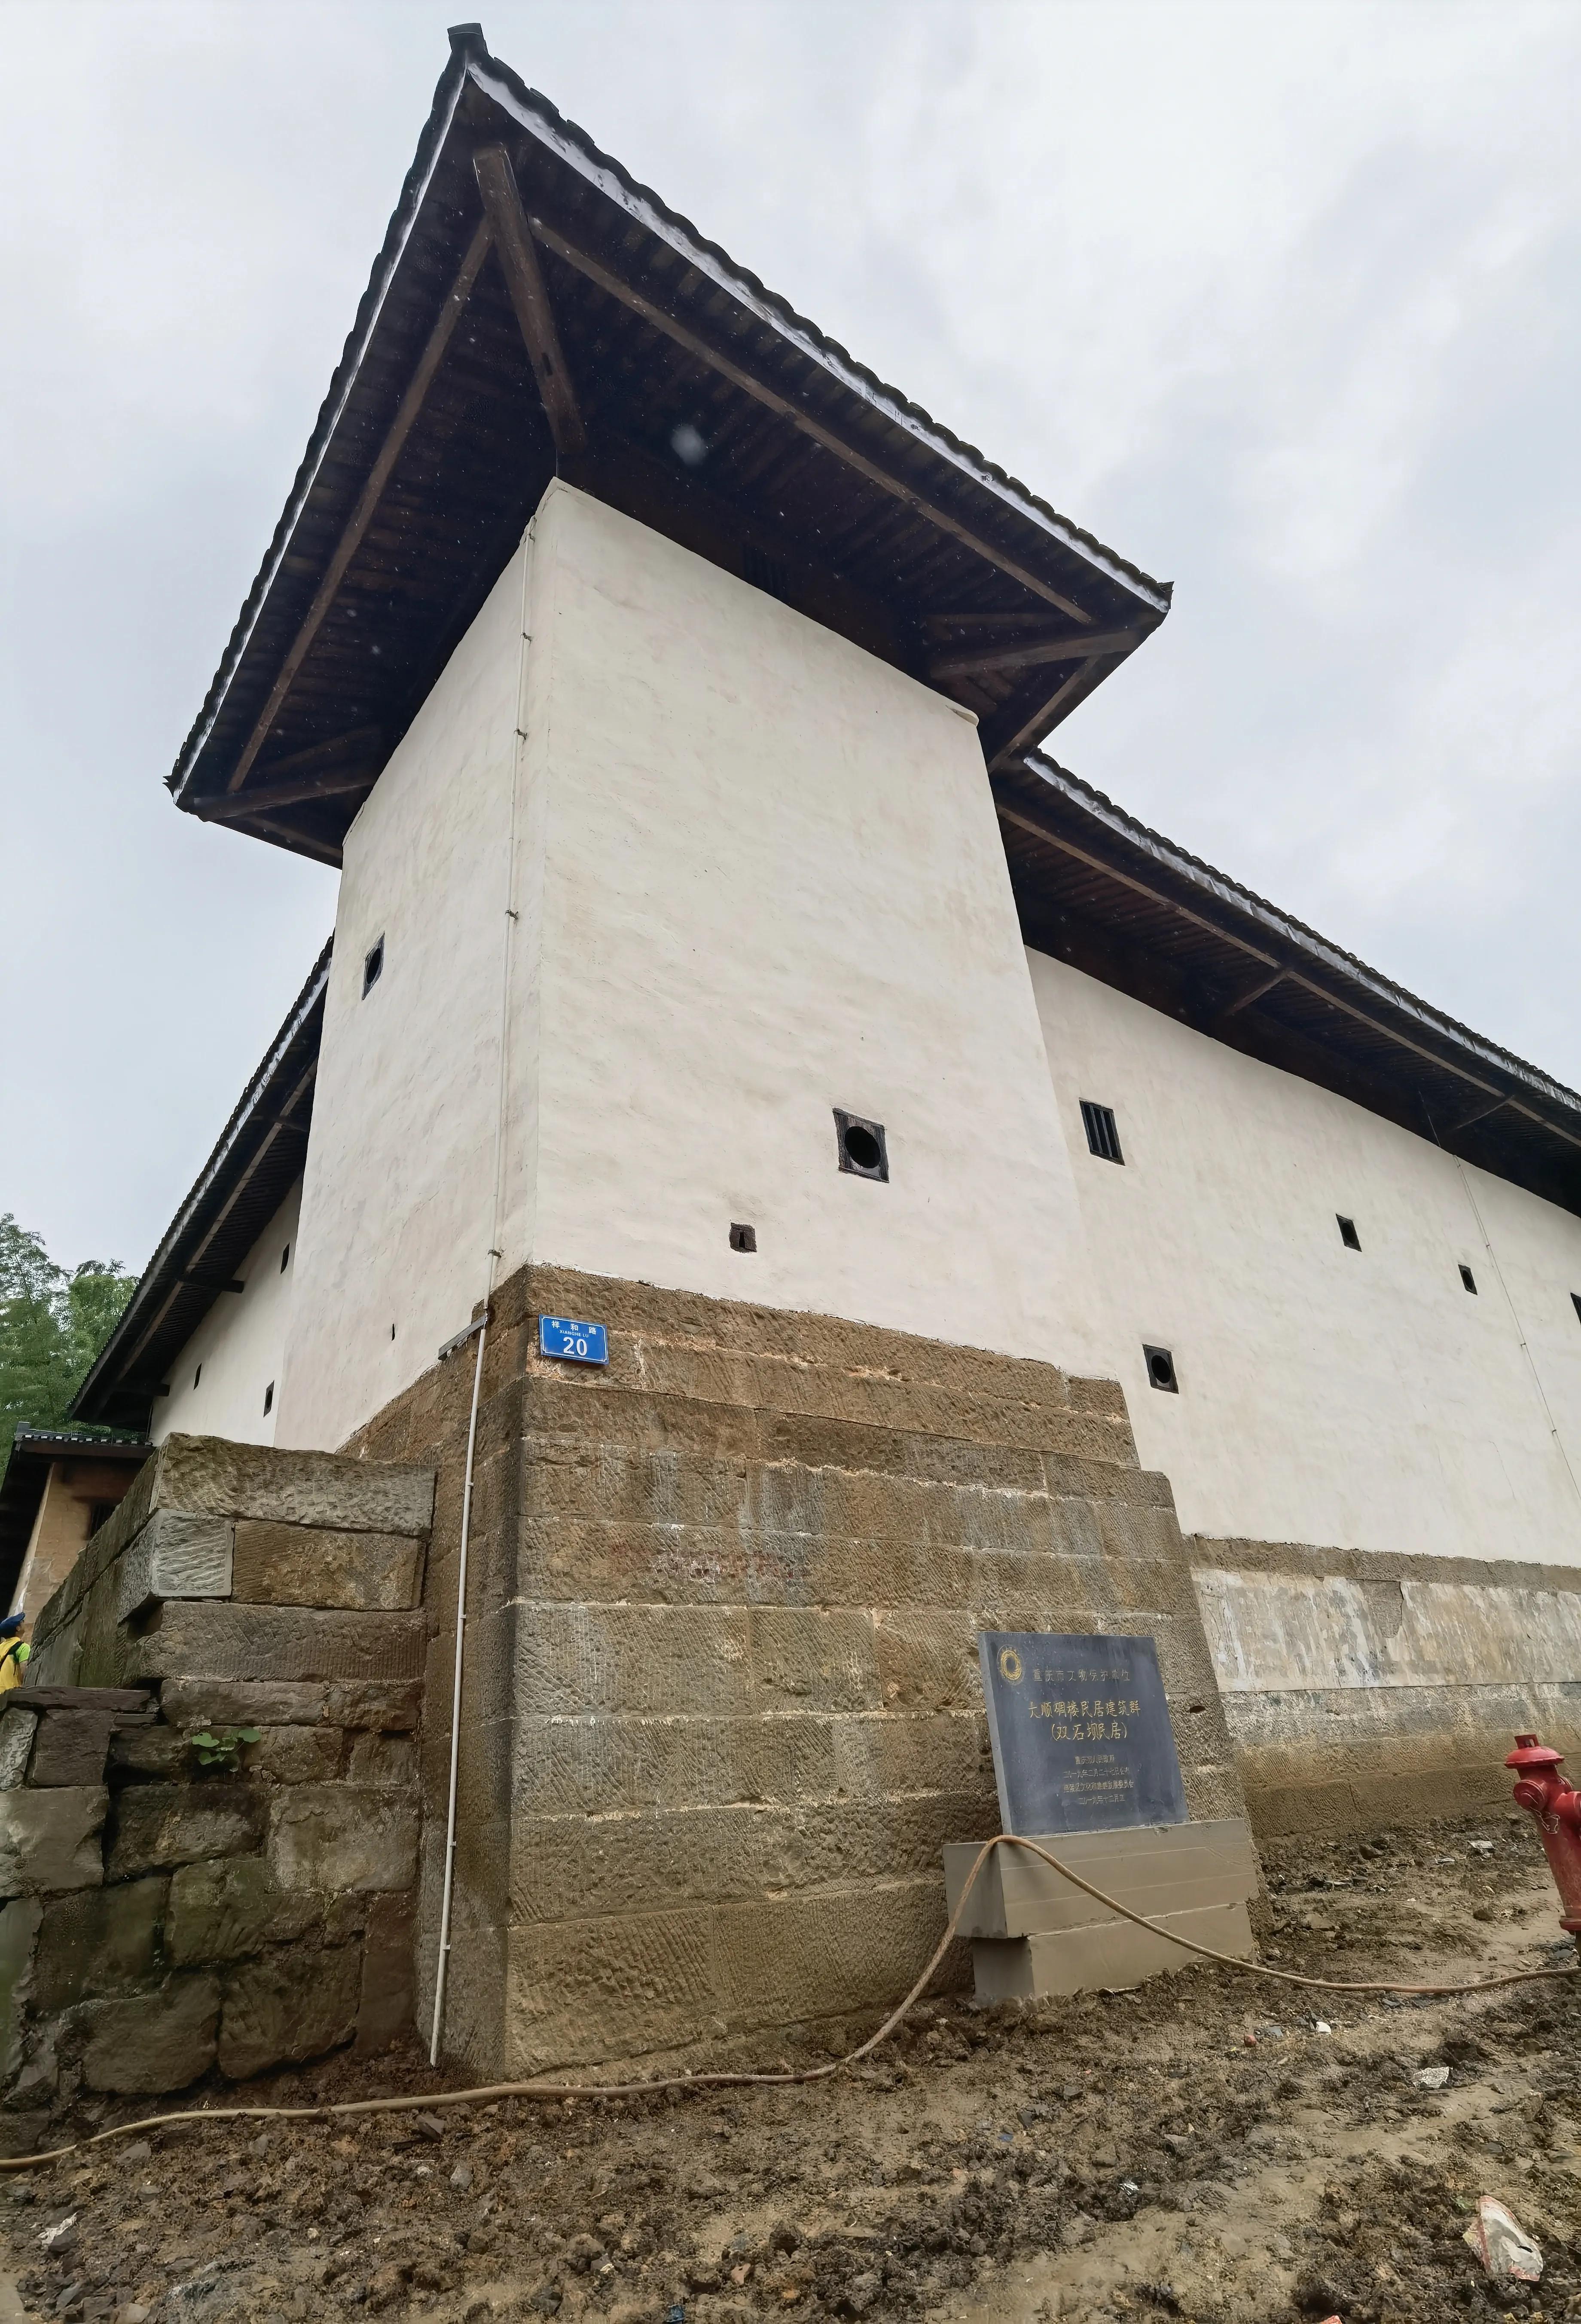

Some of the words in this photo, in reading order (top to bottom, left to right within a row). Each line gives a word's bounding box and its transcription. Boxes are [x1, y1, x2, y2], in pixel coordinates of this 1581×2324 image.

[552, 1320, 596, 1335] 祥和路
[563, 1336, 587, 1356] 20
